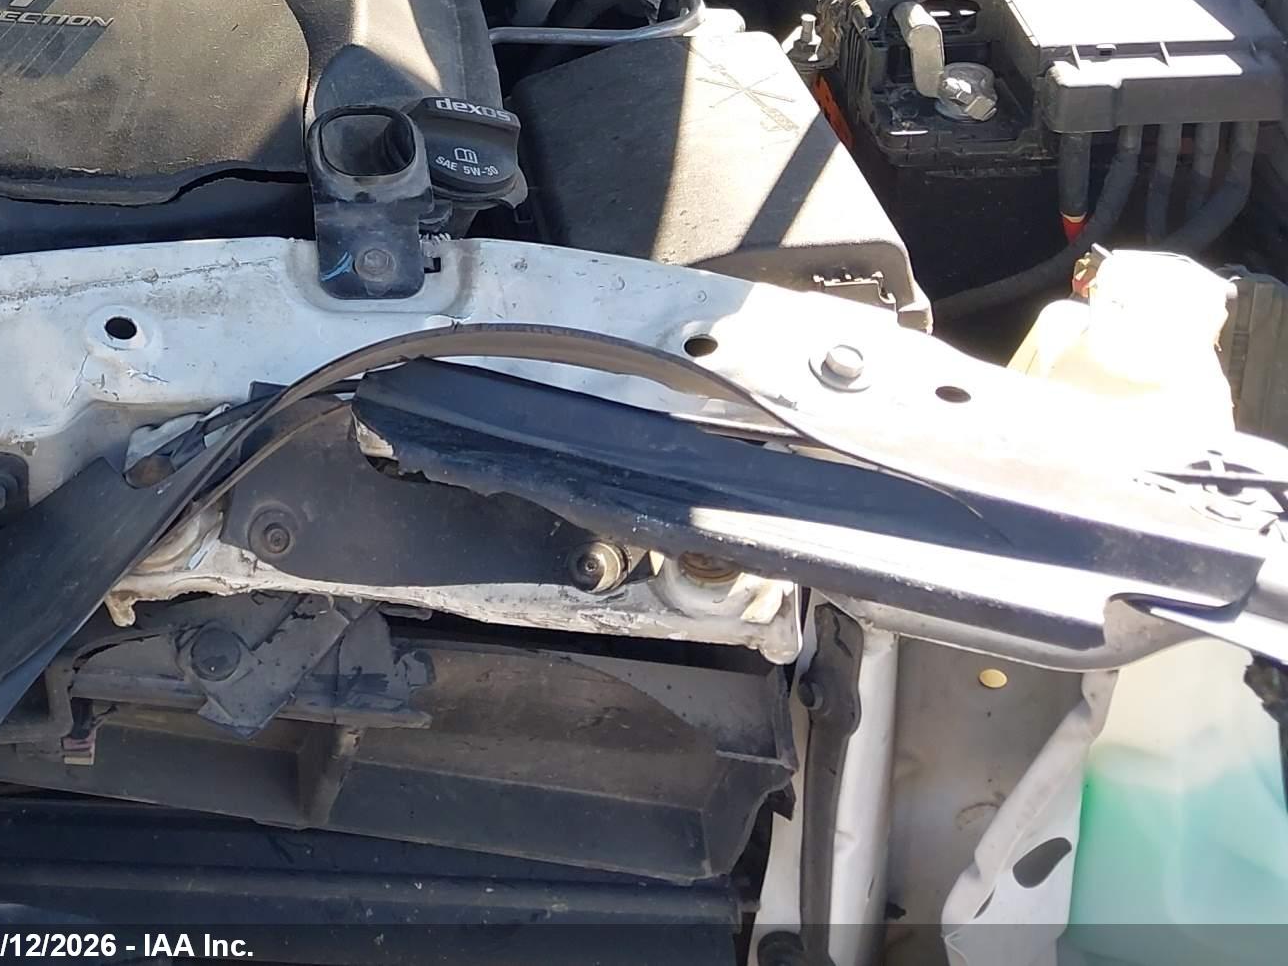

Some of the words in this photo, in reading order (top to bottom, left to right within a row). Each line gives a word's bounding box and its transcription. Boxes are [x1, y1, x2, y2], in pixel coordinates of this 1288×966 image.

[435, 97, 511, 122] dexos
[435, 155, 457, 172] SAE
[463, 164, 499, 177] 5W-30
